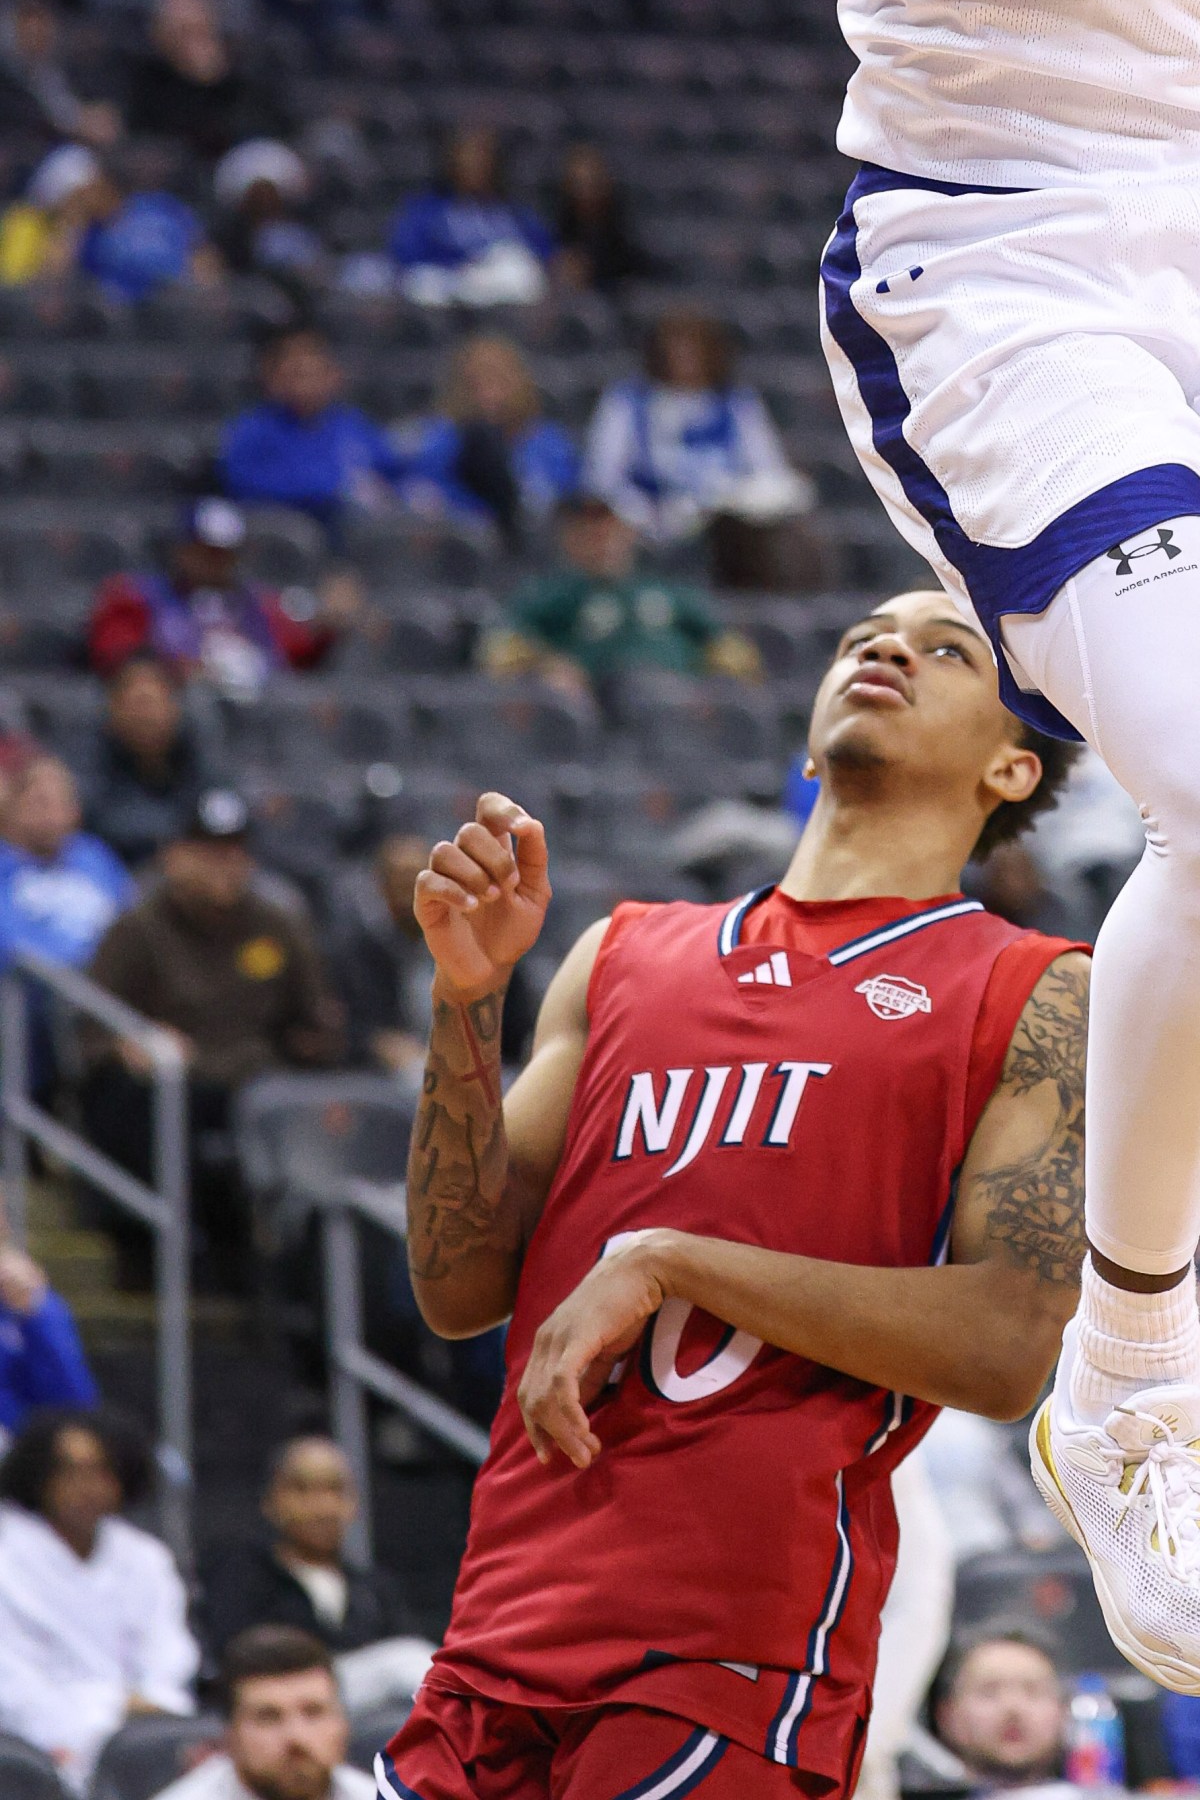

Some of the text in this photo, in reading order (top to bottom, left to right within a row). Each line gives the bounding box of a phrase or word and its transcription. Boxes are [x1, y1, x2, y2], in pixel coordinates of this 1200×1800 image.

[1115, 564, 1198, 597] UNDER ARMOUR
[862, 983, 928, 1009] AMERICA
[873, 993, 911, 1011] EAST
[610, 1061, 834, 1179] NJIT
